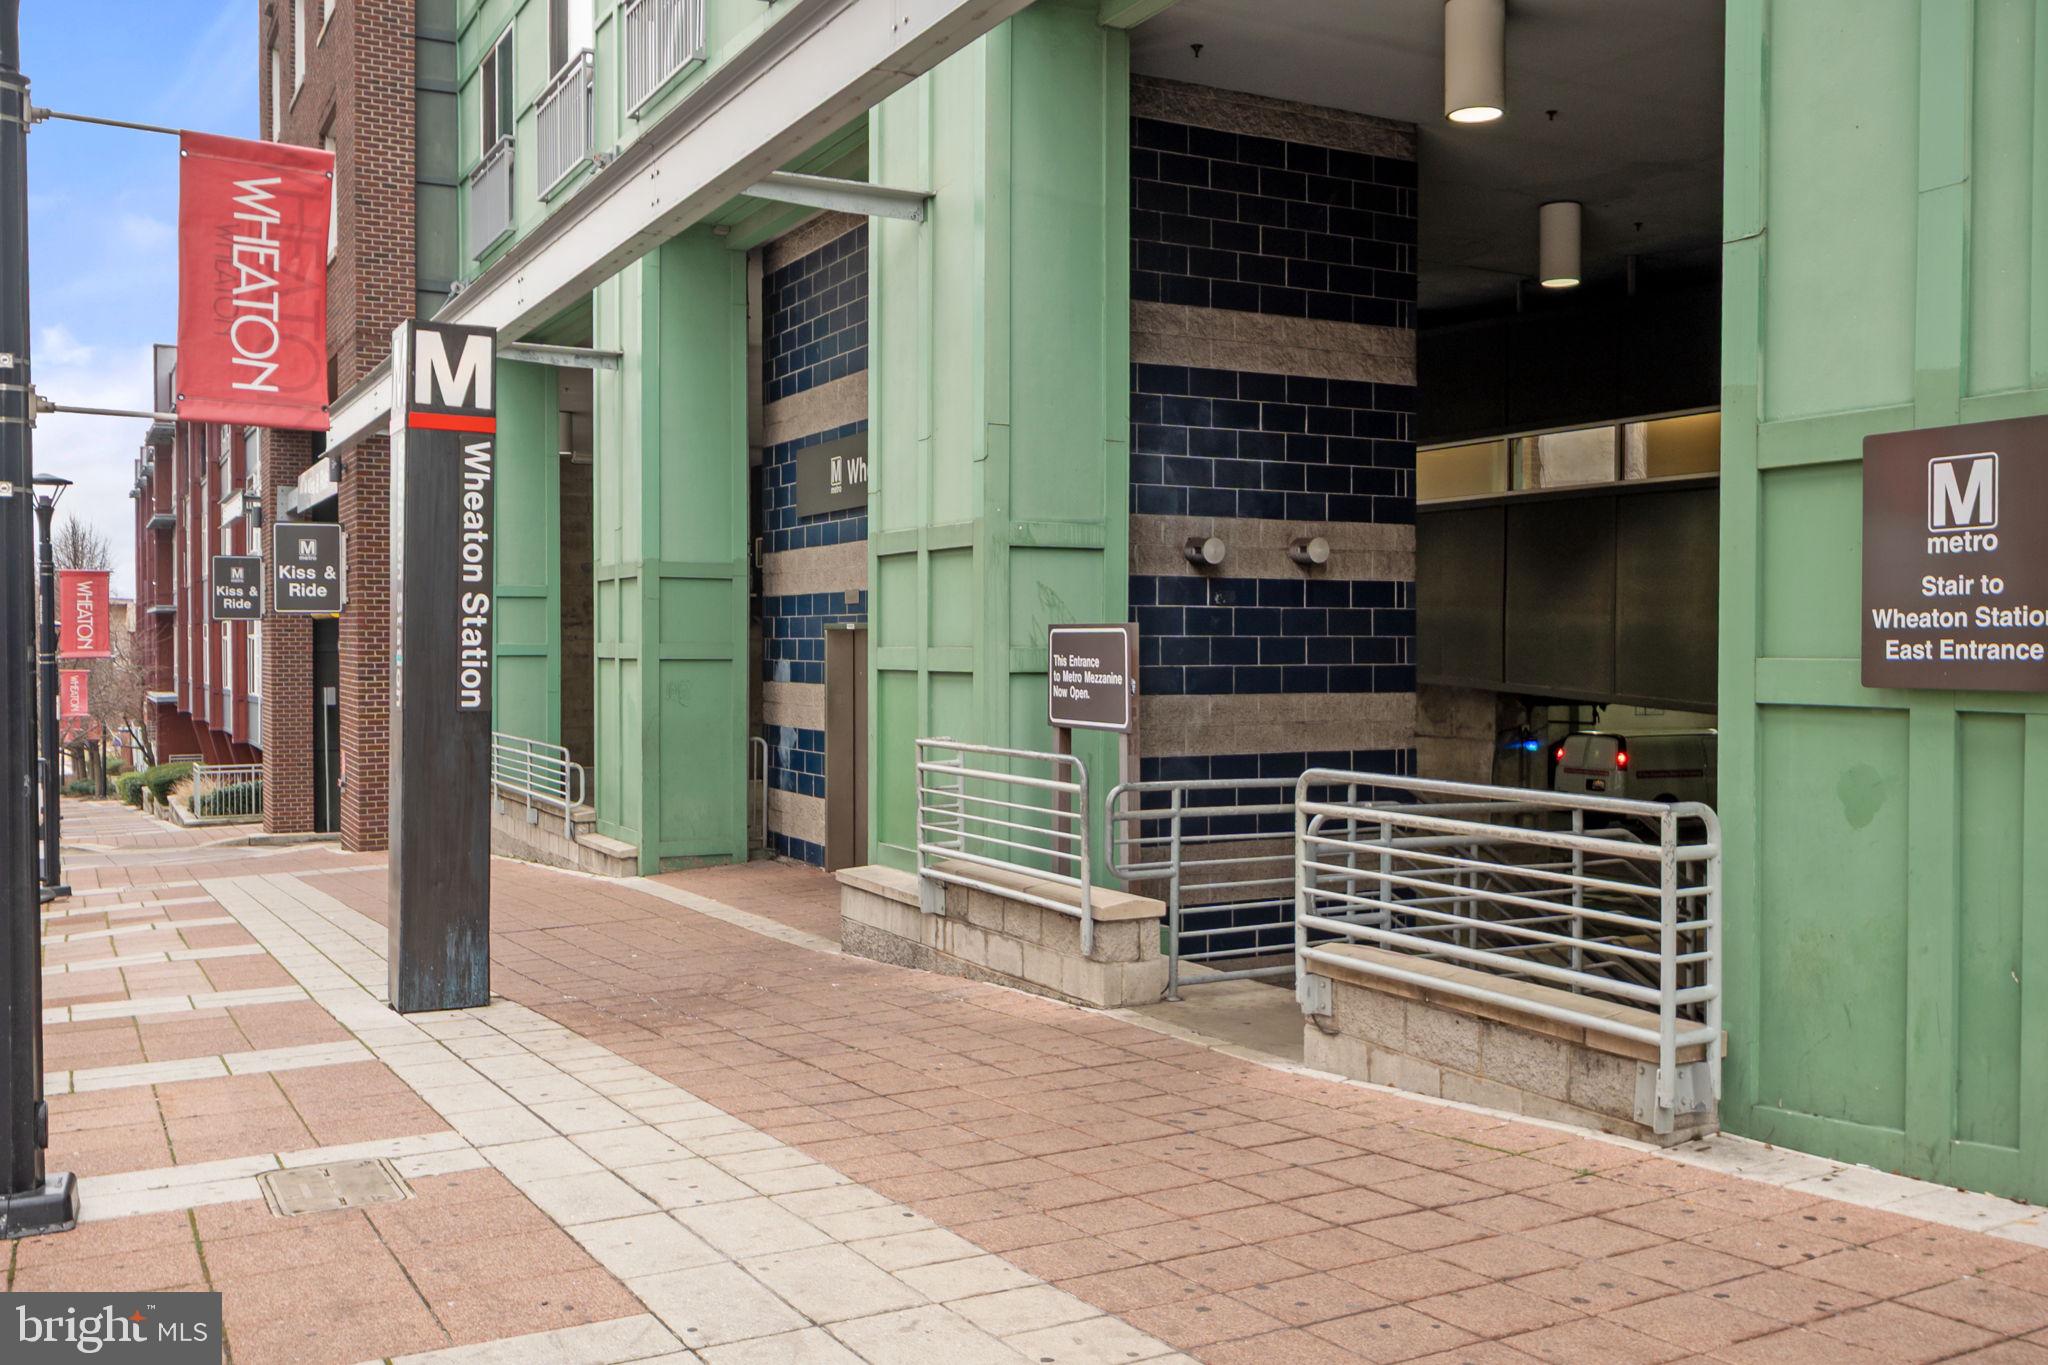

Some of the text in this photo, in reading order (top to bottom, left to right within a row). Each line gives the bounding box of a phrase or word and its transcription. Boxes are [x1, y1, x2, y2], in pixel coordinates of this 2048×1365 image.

[230, 177, 281, 392] WHEATON
[415, 329, 492, 410] M
[832, 458, 841, 484] M
[847, 457, 868, 485] Wh
[1933, 458, 1993, 527] M
[300, 540, 316, 555] M
[1927, 531, 1998, 554] metro
[231, 568, 244, 579] M
[279, 565, 336, 580] Kiss &
[460, 441, 491, 708] Wheaton Station
[216, 586, 258, 597] Kiss &
[289, 583, 328, 597] Ride
[1922, 574, 2004, 597] Stair to
[223, 598, 252, 609] Ride
[76, 581, 93, 649] WHEATON
[1872, 604, 2048, 629] Wheaton Statio
[1885, 638, 2044, 660] East Entrance
[1053, 655, 1100, 668] This Entrance
[1053, 670, 1123, 685] to Metro Mezzanine
[1053, 685, 1090, 700] Now Open.
